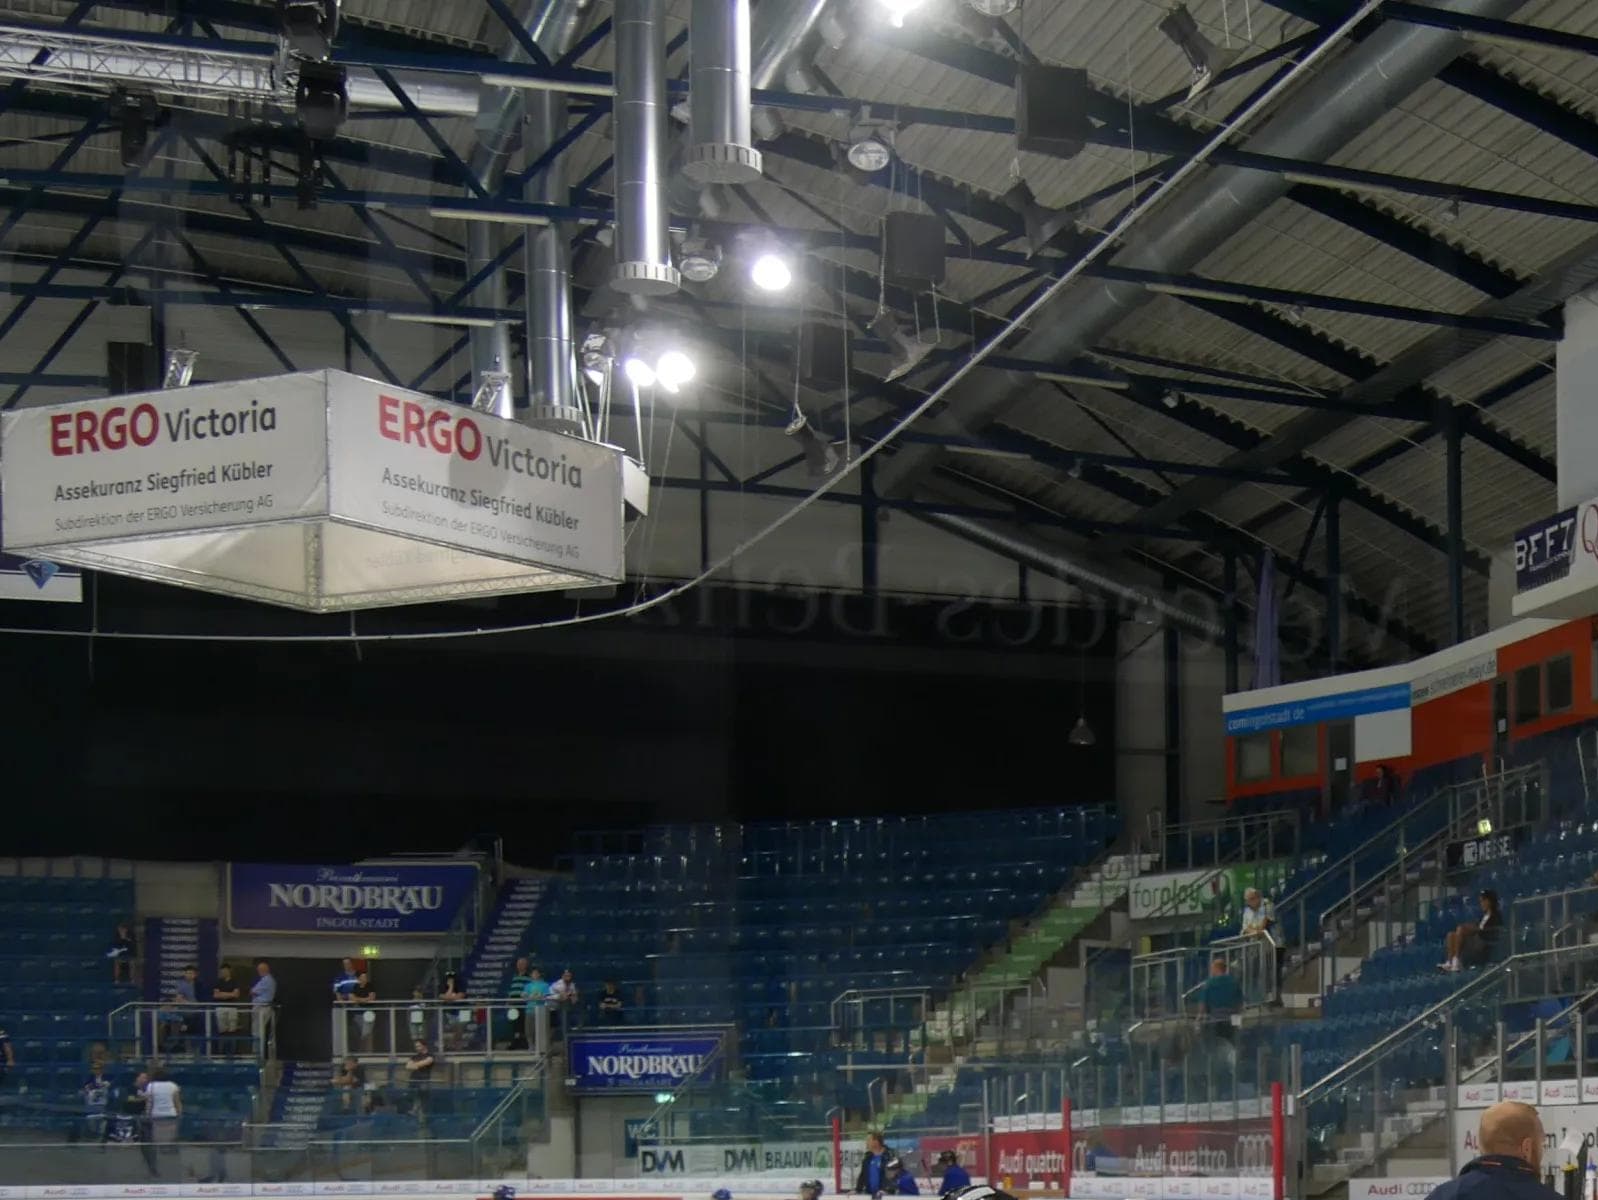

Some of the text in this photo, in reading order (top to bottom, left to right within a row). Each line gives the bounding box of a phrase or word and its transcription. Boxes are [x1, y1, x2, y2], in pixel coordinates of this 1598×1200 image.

[50, 400, 277, 457] ERGO Victoria
[378, 394, 582, 488] ERGO Victoria
[54, 462, 273, 501] Assekuranz Siegfried Kübler
[55, 494, 273, 531] Subdirektion der ERGO Versicherung AG
[382, 467, 579, 531] Assekuranz Siegfried Kübler
[381, 501, 580, 560] Subdirektion der ERGO Versicherung AG
[268, 883, 444, 914] NORDBRÄU
[316, 917, 401, 929] INGOLSTADT
[587, 1054, 704, 1078] NORDBRÄU
[1544, 1087, 1560, 1098] Audi
[642, 1150, 685, 1173] DVM
[724, 1149, 759, 1170] DVM
[765, 1152, 813, 1169] BRAUN
[1000, 1149, 1024, 1172] Audi
[1135, 1145, 1227, 1178] Audi quattro
[1368, 1183, 1403, 1196] Audi
